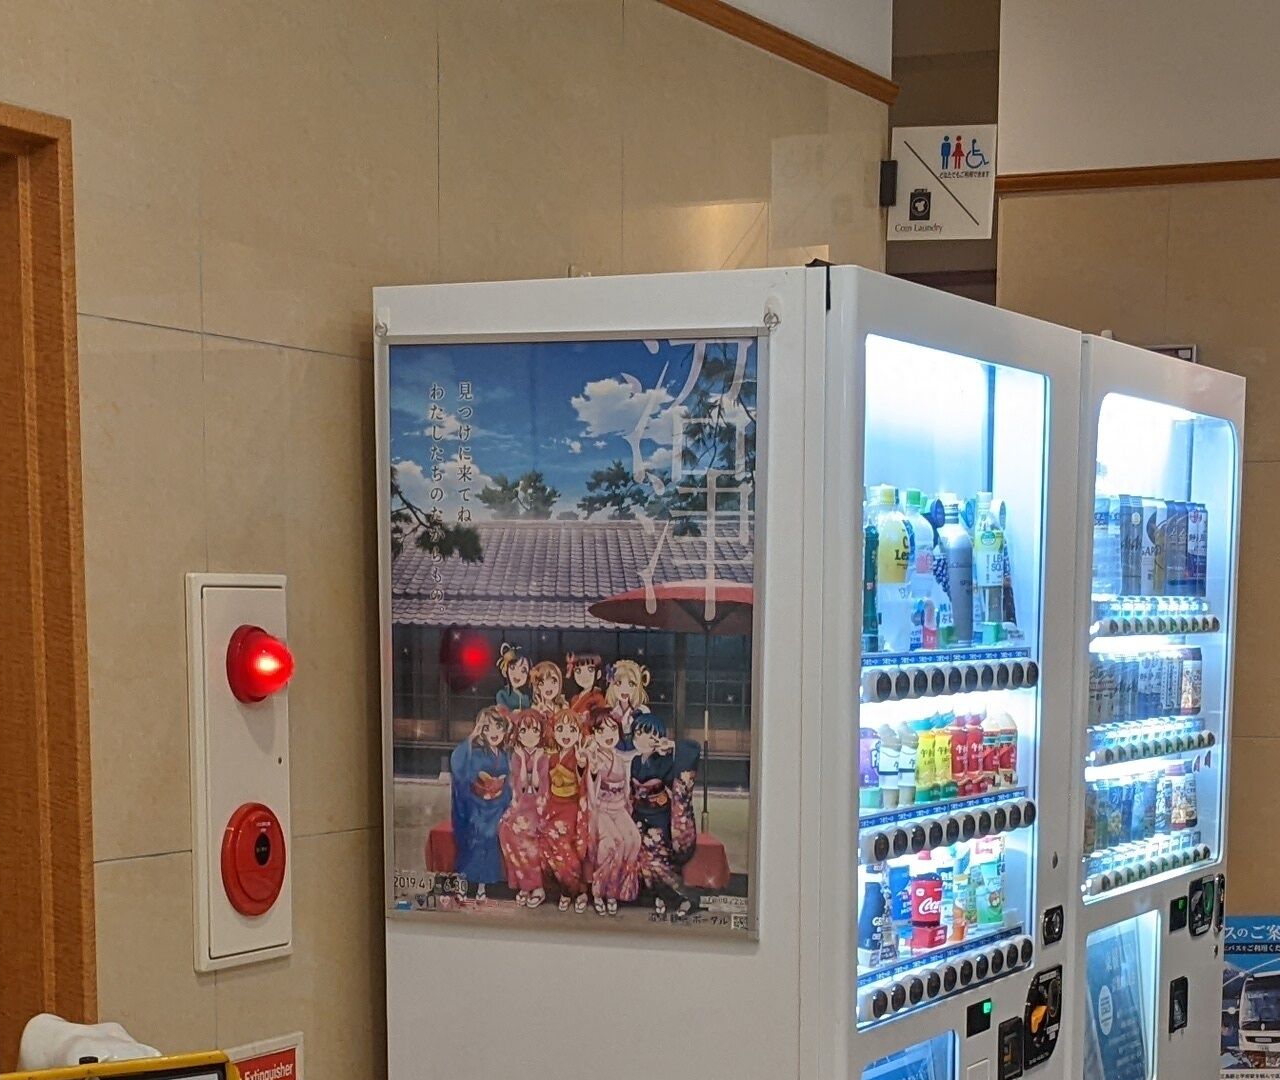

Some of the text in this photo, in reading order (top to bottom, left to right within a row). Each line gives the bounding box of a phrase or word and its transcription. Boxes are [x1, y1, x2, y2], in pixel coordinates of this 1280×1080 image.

[895, 222, 943, 234] Coin Laundry
[456, 381, 474, 524] 見つけに来てね
